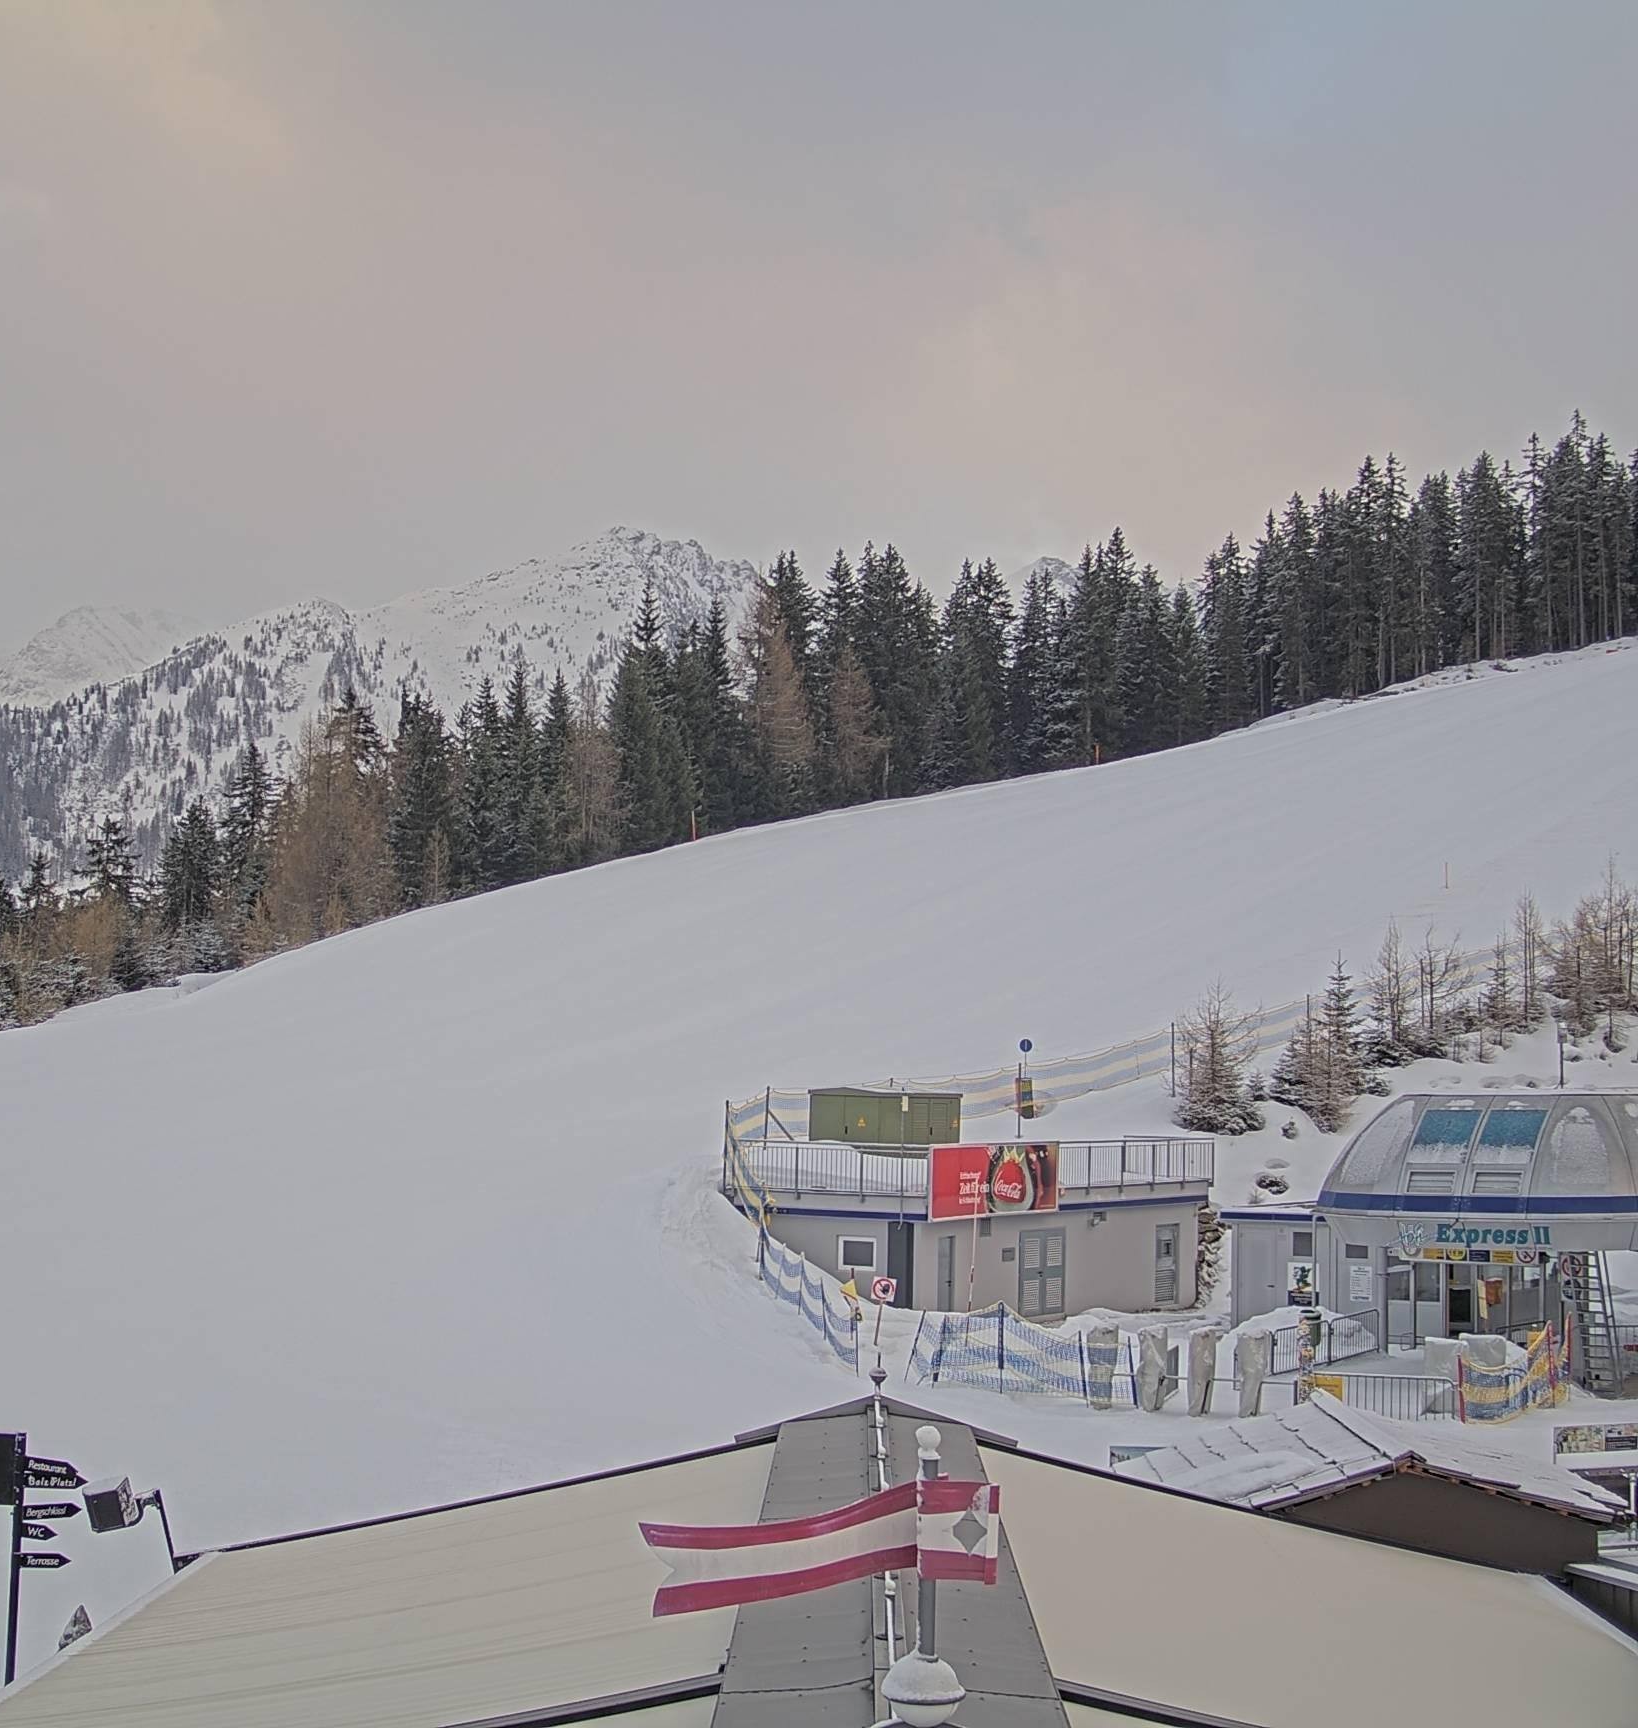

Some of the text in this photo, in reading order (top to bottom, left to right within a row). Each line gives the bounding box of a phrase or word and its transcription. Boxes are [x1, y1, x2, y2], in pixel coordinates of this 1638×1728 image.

[1436, 1224, 1529, 1248] Express
[1532, 1226, 1551, 1245] II
[28, 1460, 67, 1475] Restaurant
[28, 1526, 45, 1537] WC
[26, 1555, 60, 1566] Terrasse
